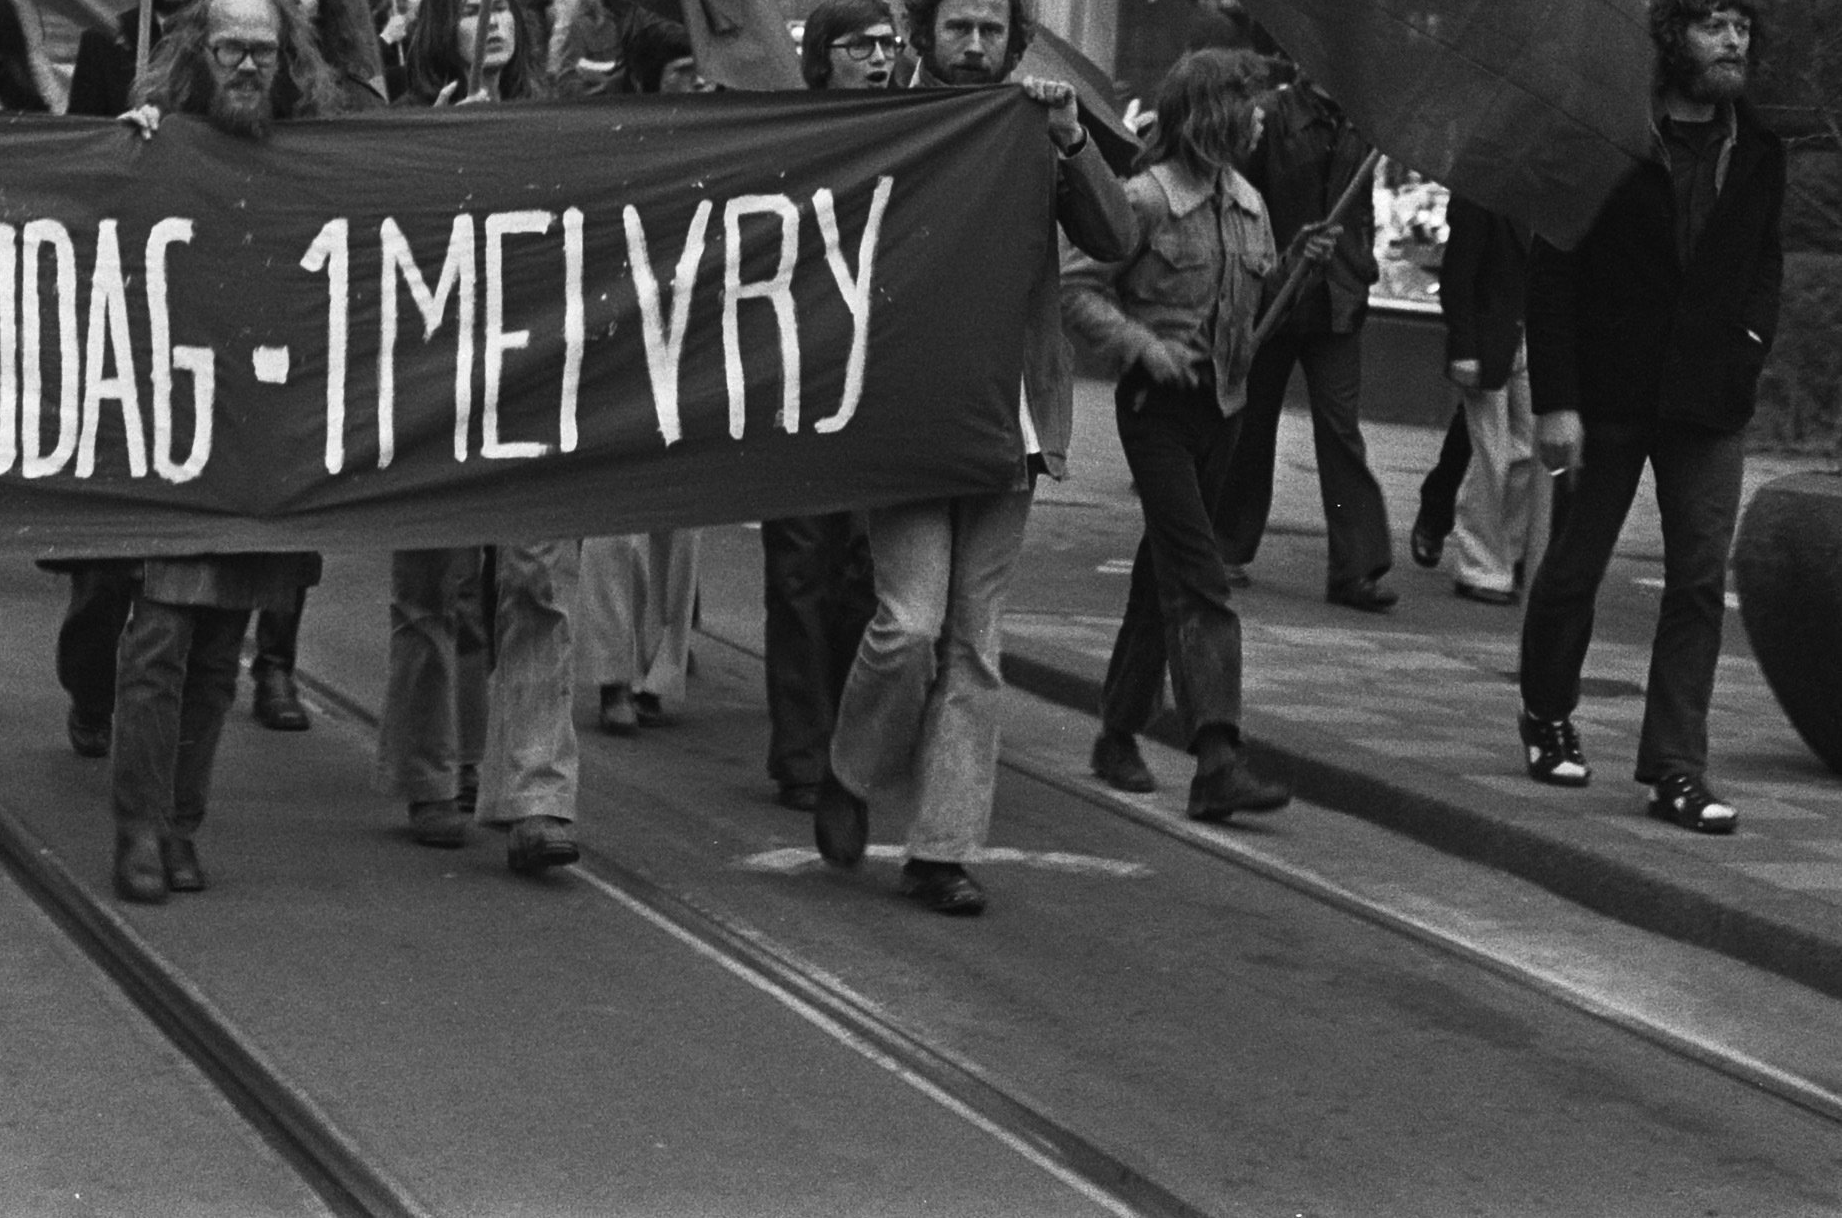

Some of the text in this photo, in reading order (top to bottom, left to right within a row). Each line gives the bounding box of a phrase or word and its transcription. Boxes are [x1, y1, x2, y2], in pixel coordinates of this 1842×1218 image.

[298, 218, 349, 474] 1
[377, 207, 585, 468] MEI
[623, 175, 894, 446] VRY
